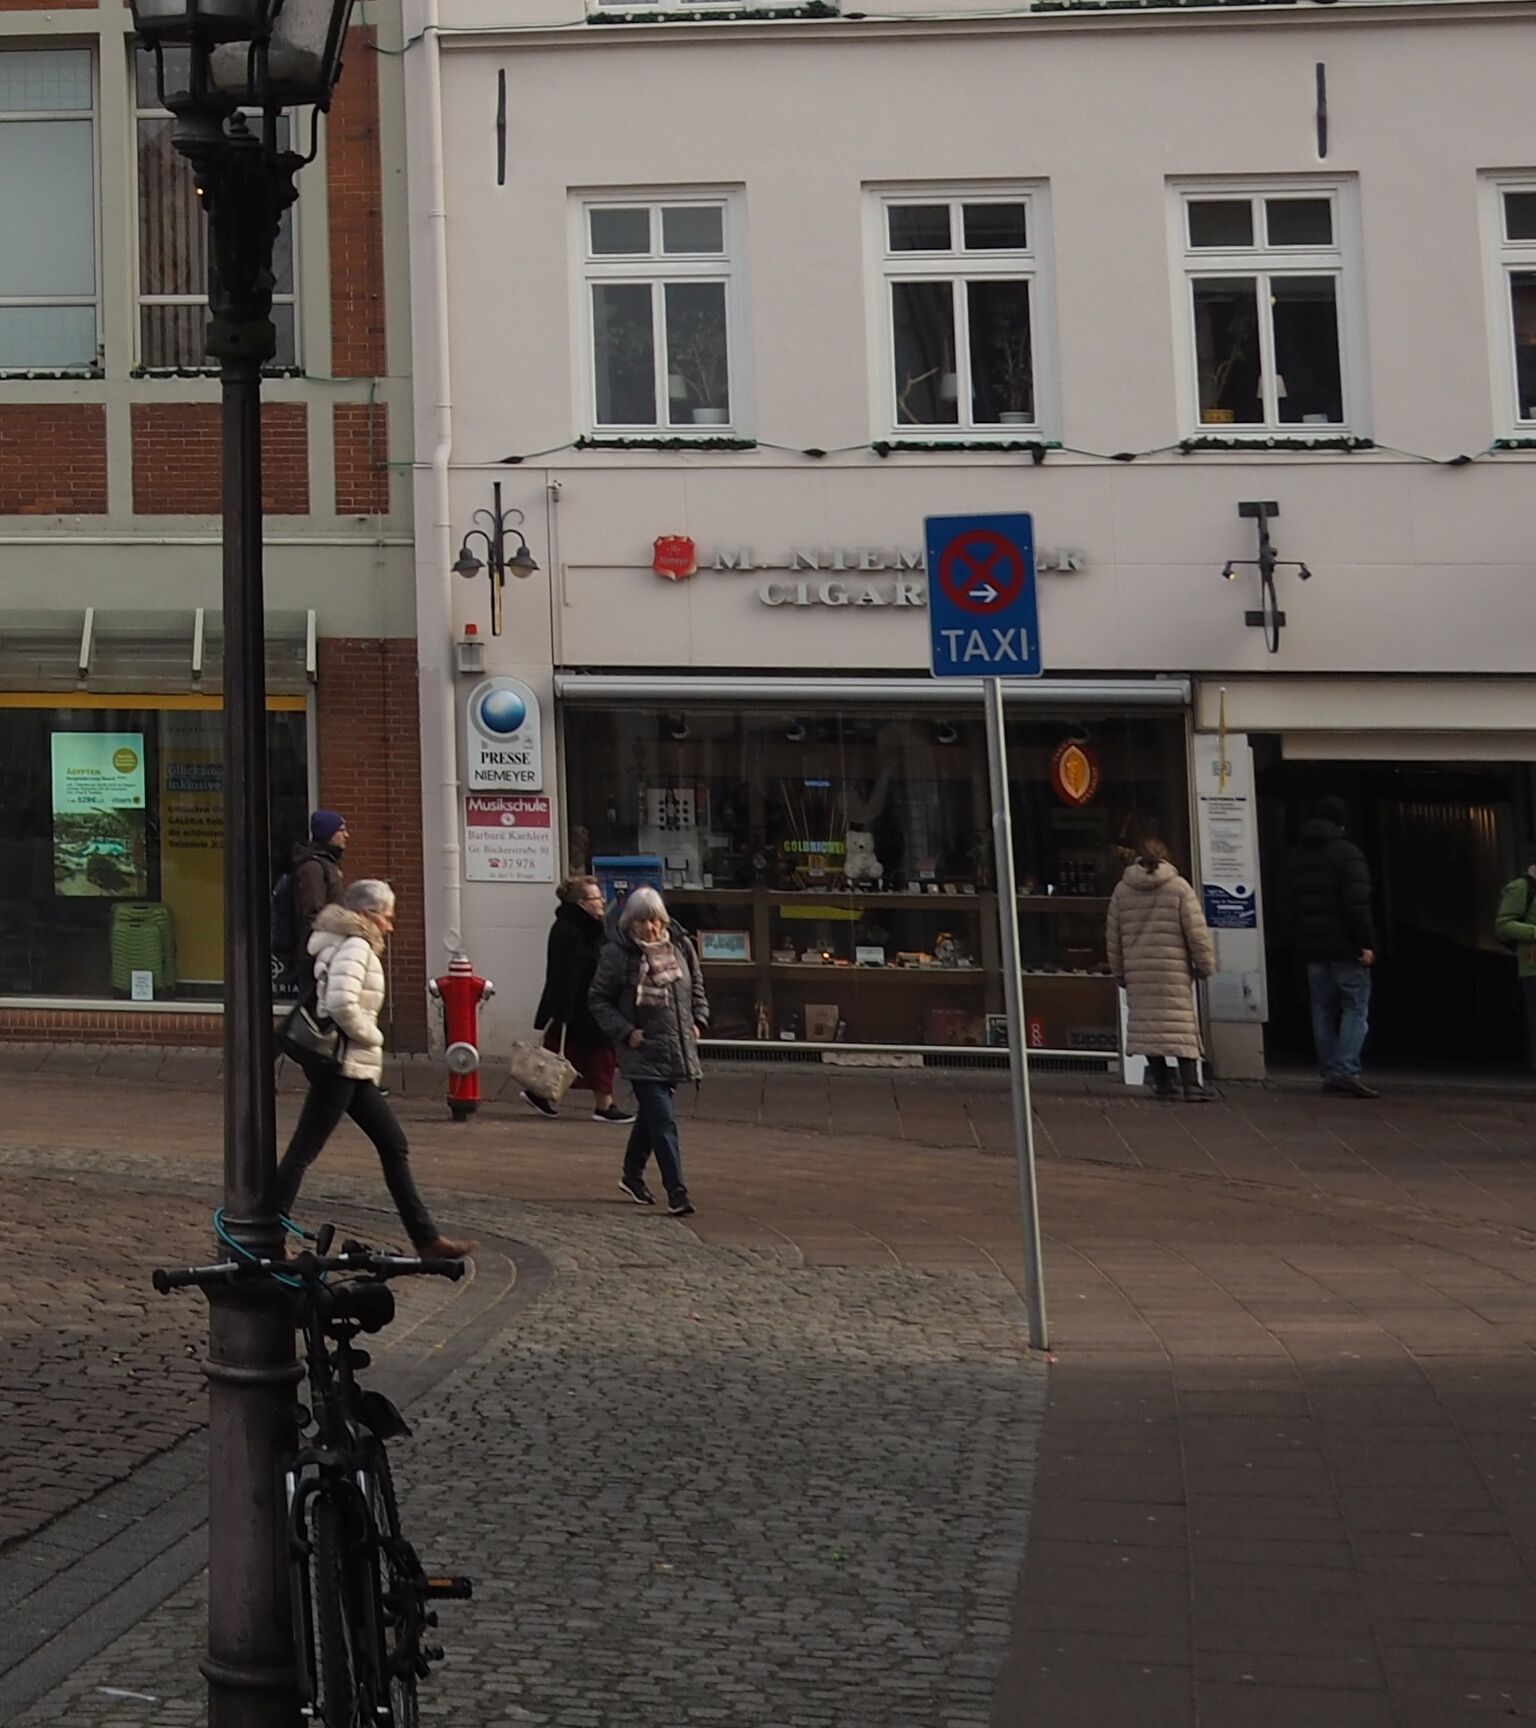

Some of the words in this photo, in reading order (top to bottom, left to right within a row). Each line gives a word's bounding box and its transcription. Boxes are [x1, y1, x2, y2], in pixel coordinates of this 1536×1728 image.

[758, 582, 928, 607] CIGAR
[940, 628, 1029, 663] TAXI
[480, 752, 531, 765] PRESSE
[474, 770, 535, 782] NIEMEYER
[468, 797, 548, 812] Musikschule
